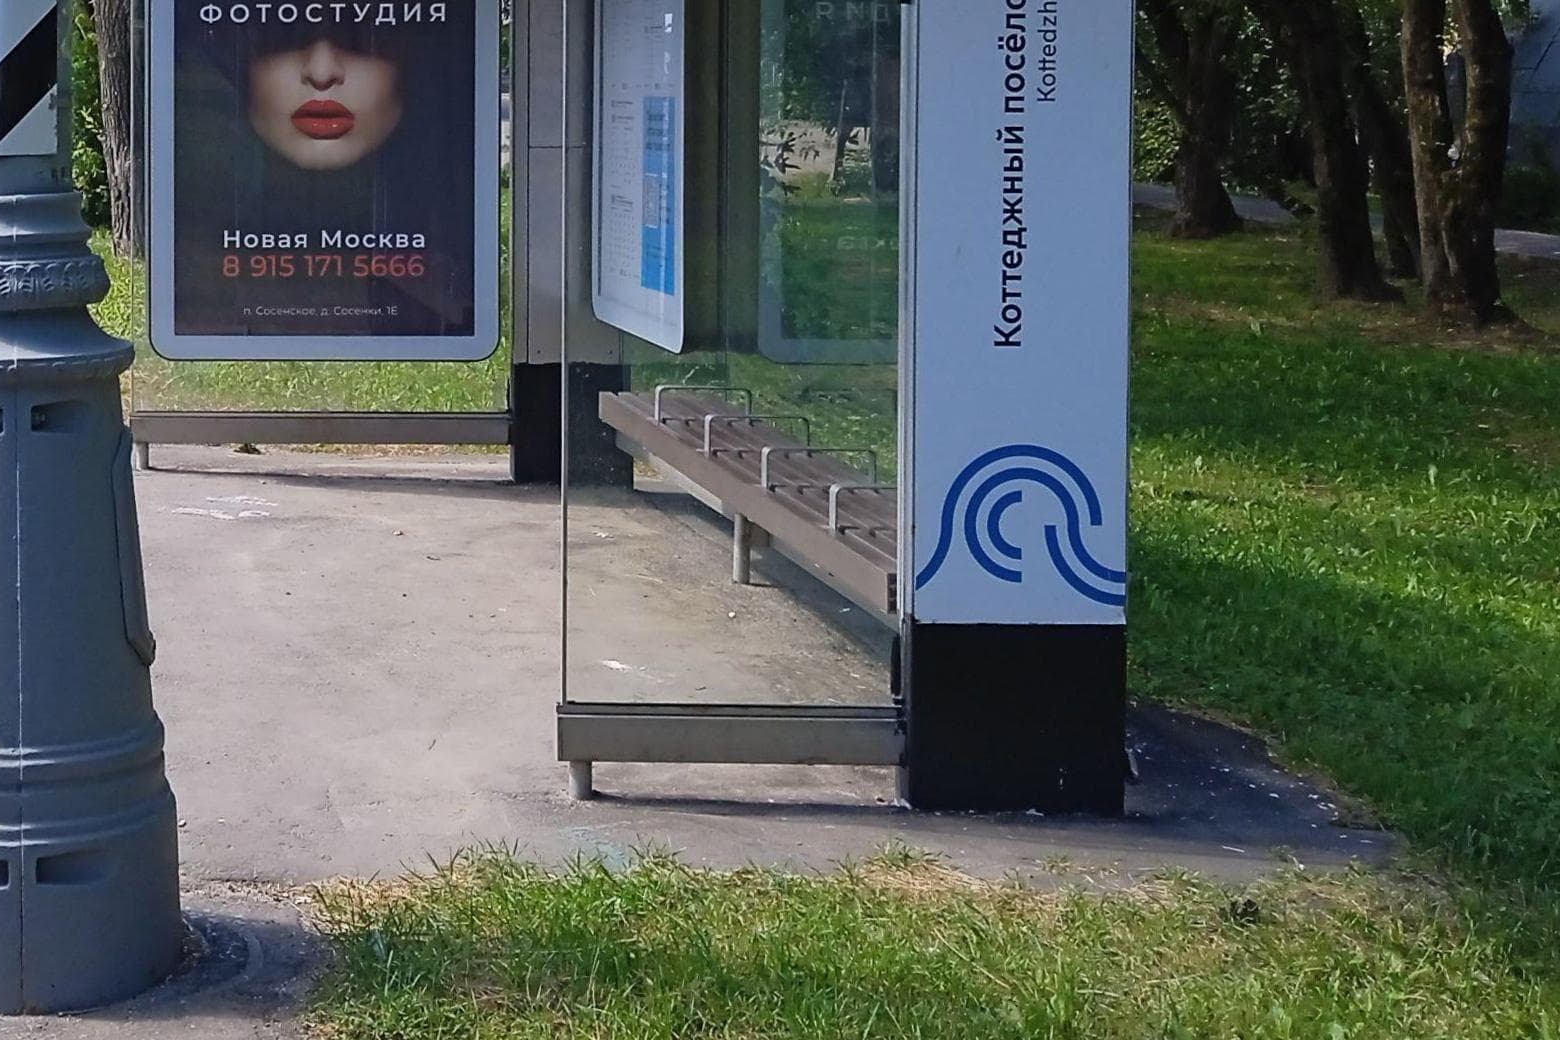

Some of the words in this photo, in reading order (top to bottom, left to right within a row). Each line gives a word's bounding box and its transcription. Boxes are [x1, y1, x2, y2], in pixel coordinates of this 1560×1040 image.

[199, 2, 447, 25] ФОТОСТУДИЯ
[223, 230, 308, 249] Новая
[321, 230, 426, 249] Москва
[994, 126, 1027, 347] Коттеджный
[222, 255, 241, 278] 8
[250, 255, 295, 278] 915
[303, 255, 343, 278] 171
[352, 254, 425, 278] 5666
